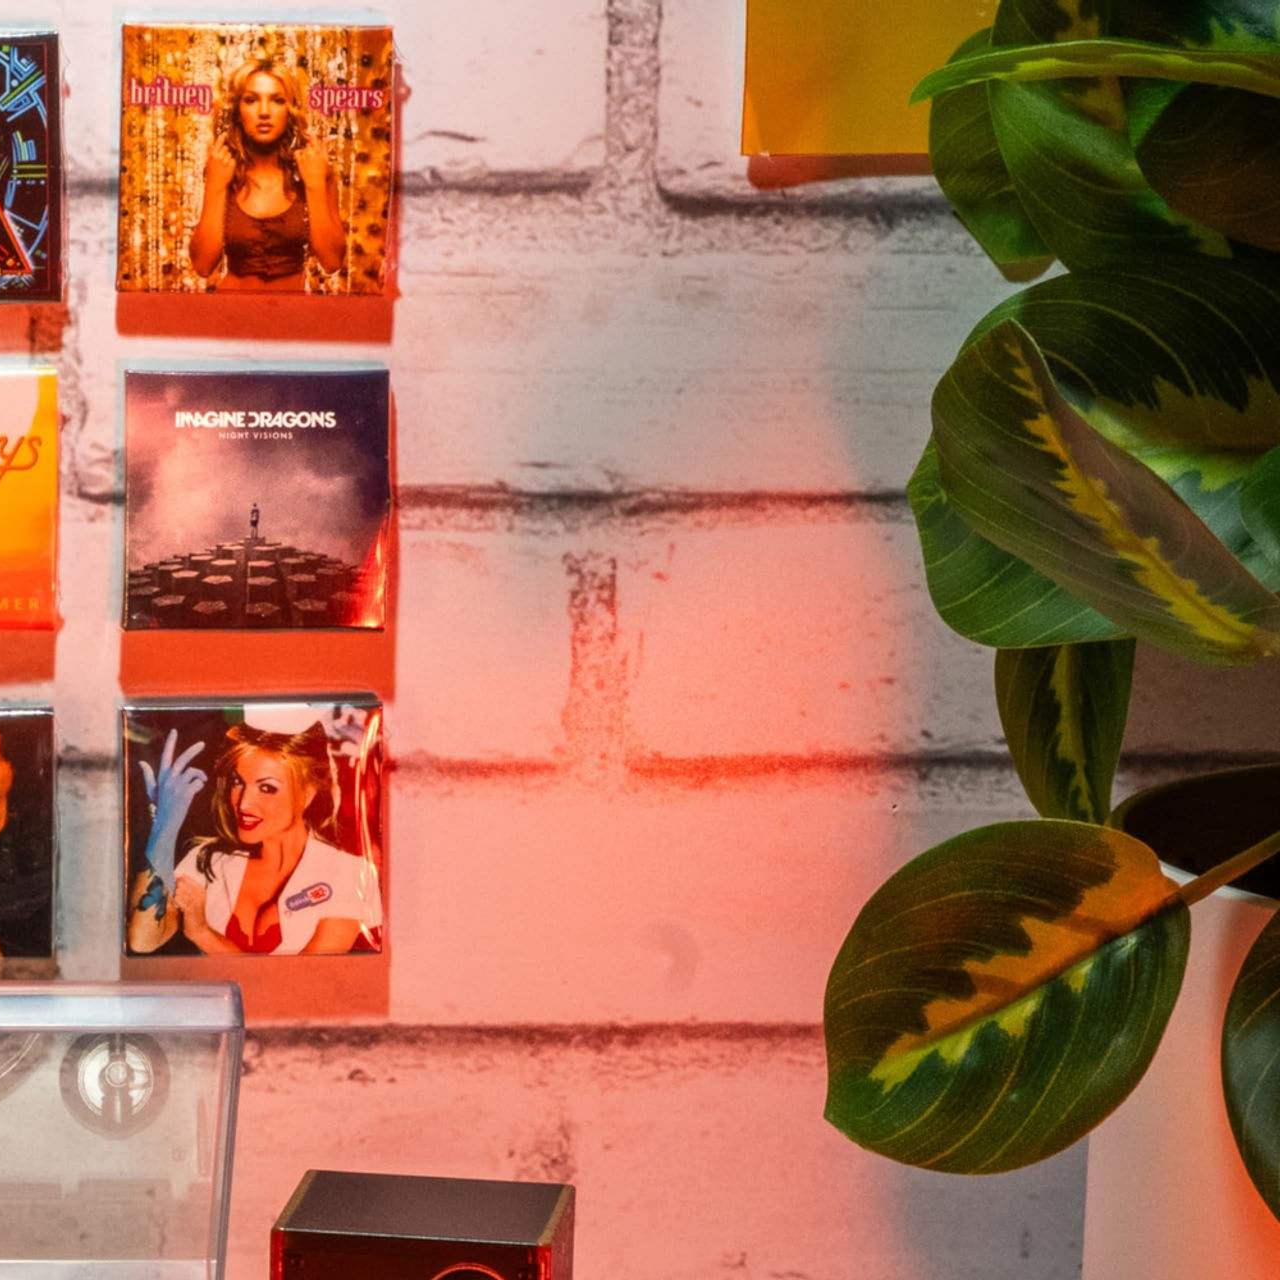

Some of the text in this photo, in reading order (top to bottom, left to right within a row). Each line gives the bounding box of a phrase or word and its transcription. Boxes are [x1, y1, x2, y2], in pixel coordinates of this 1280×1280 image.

[130, 77, 385, 115] britney spears
[175, 411, 337, 429] IMAGINE DRAGONS
[219, 431, 293, 440] NIGHT VISIONS
